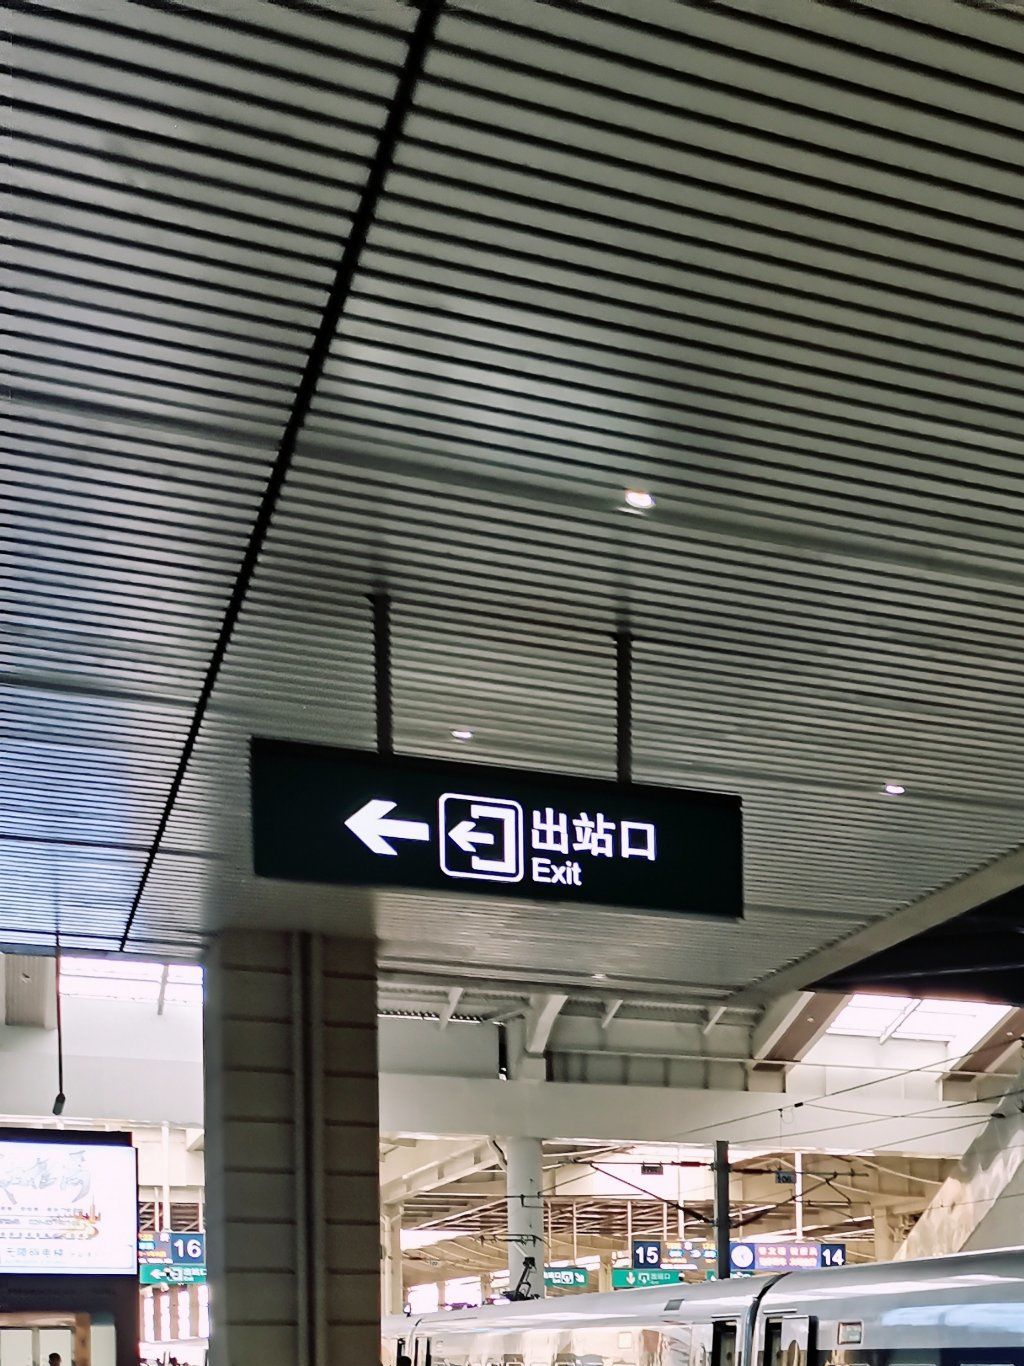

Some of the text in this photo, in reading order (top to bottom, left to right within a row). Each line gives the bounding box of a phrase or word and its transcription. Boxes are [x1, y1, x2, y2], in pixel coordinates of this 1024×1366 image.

[531, 807, 656, 861] 出站口
[532, 857, 582, 886] Exit
[174, 1239, 201, 1258] 16
[637, 1246, 659, 1264] 15
[822, 1248, 843, 1266] 14
